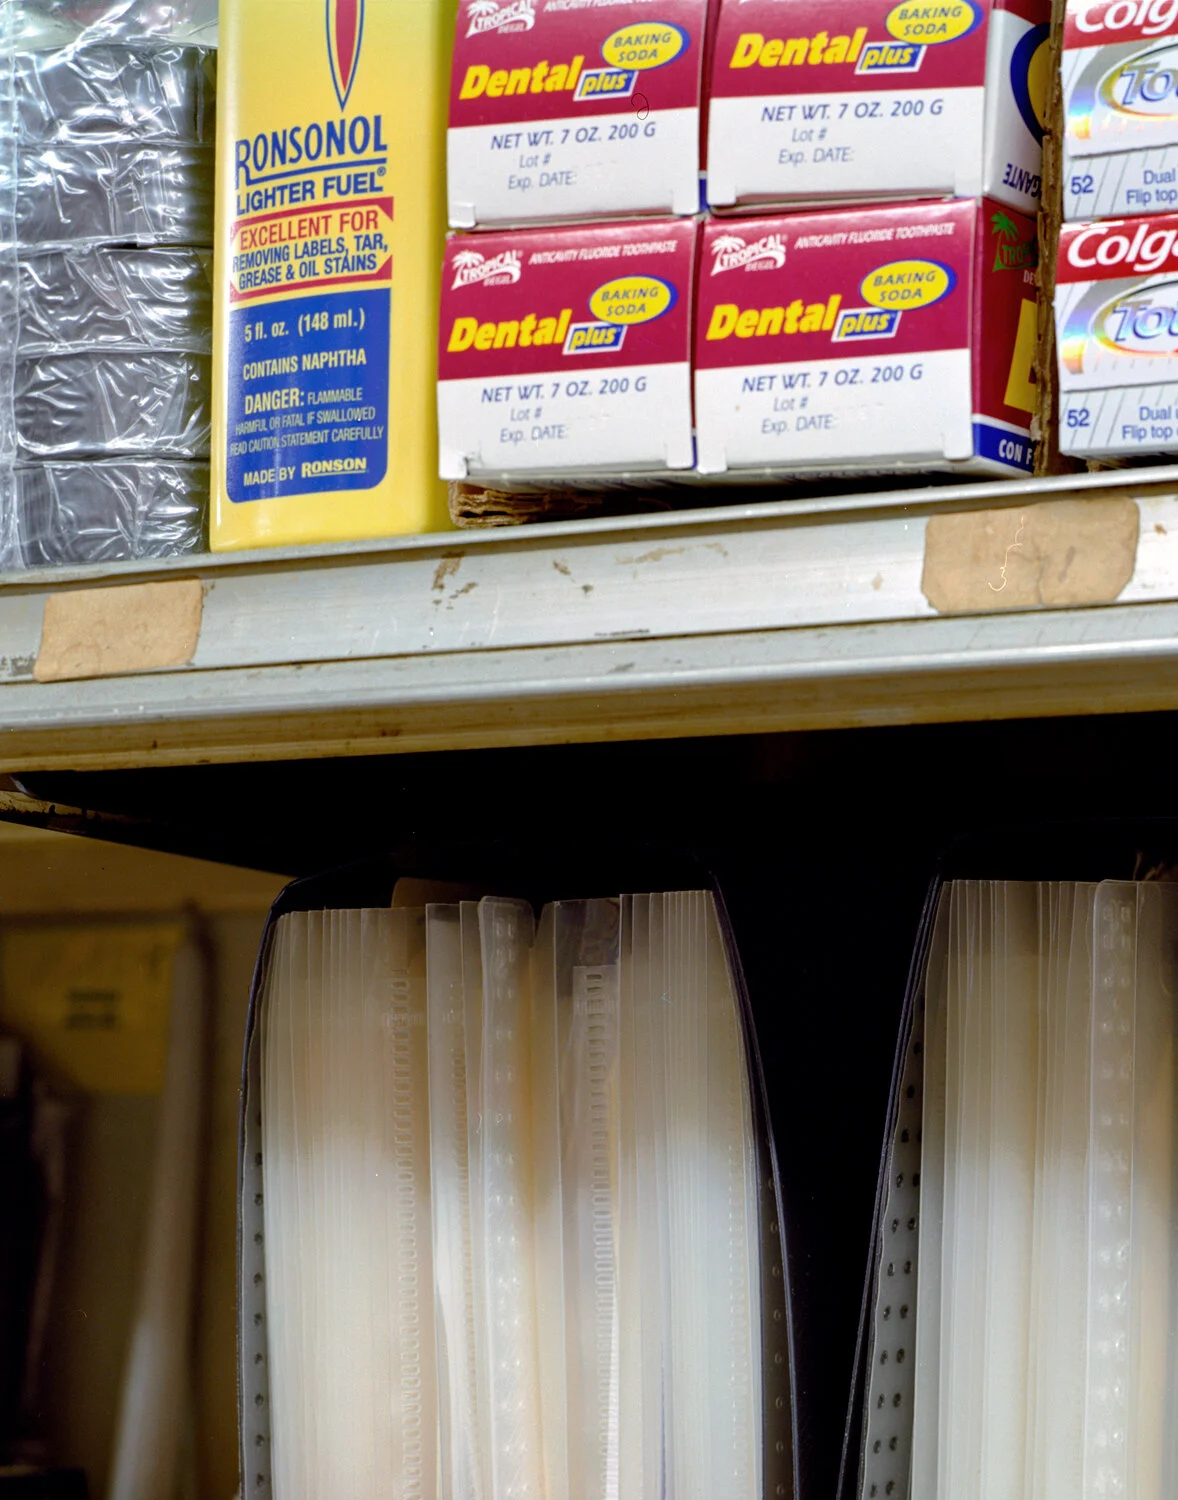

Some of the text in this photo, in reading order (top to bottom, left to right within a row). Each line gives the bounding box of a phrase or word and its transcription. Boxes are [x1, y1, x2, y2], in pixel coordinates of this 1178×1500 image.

[898, 6, 962, 20] BAKING
[613, 32, 672, 48] BAKING
[903, 23, 947, 37] SODA
[618, 49, 658, 62] SODA
[729, 27, 914, 70] Dental plus
[459, 55, 630, 100] Dental plus
[761, 99, 943, 122] NET WT. 7 OZ. 200 G
[792, 127, 828, 143] Lot #
[235, 115, 388, 190] RONSONOL
[778, 147, 854, 166] Exp. DATE:
[1070, 174, 1095, 195] 52
[236, 180, 315, 216] LIGHTER
[240, 209, 379, 251] EXCELLENT FOR
[849, 228, 894, 245] FLUORIDE
[232, 233, 388, 273] REMOVING LABELS, TAR,
[239, 253, 377, 291] GREASE & OIL STAINS
[873, 271, 936, 287] BAKING
[601, 286, 659, 302] BAKING
[879, 288, 923, 302] SODA
[606, 304, 647, 317] SODA
[706, 294, 892, 341] Dental plus
[244, 308, 366, 343] 5 fl. oz. (148 ml.)
[447, 308, 618, 352] Dental plus
[243, 348, 367, 381] CONTAINS NAPHTHA
[742, 363, 923, 393] NET WT. 7 OZ. 200 G
[245, 387, 363, 415] DANGER: FLAMMABLE
[235, 406, 376, 436] HARMFUL OR FATAL IF SWALLOWED
[1066, 408, 1091, 428] 52
[1139, 405, 1172, 421] Dual
[249, 436, 281, 453] CAUTION
[281, 429, 329, 448] STATEMENT
[331, 426, 385, 443] CAREFULLY
[1122, 425, 1147, 442] Flip
[998, 438, 1024, 463] CON
[243, 457, 367, 486] MADE BY RONSON
